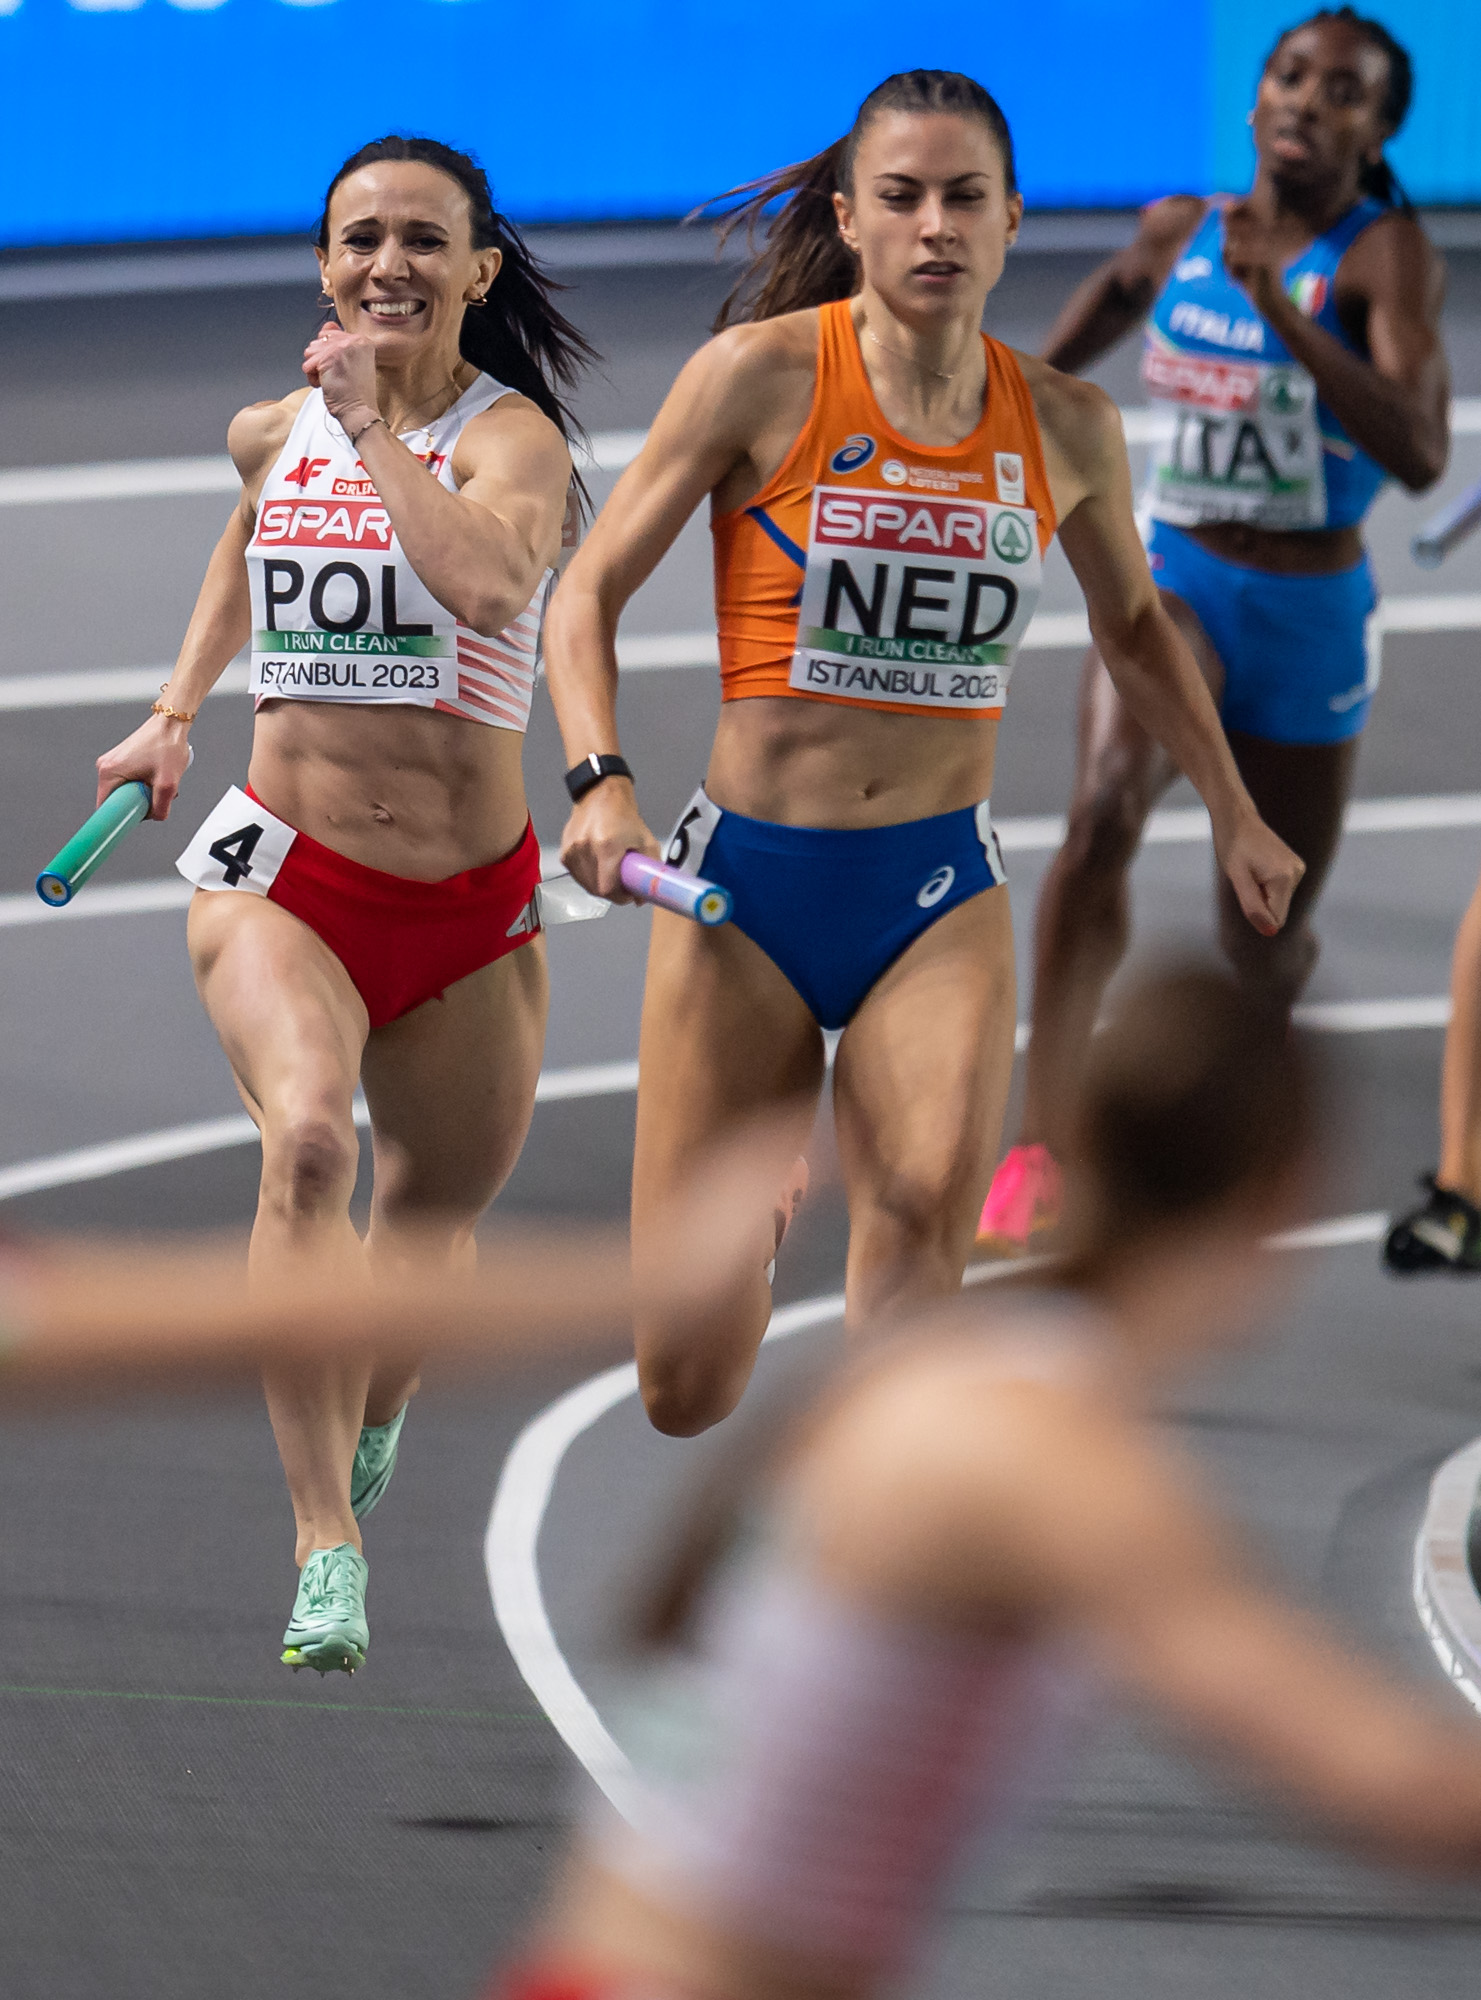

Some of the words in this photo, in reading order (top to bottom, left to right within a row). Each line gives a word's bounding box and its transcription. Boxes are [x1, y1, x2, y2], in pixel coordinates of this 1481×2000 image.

[1168, 300, 1265, 352] ITALIA
[1172, 414, 1281, 483] ITA
[284, 456, 332, 488] 4F
[260, 505, 392, 543] SPAR
[820, 499, 984, 552] SPAR
[263, 558, 434, 638] POL
[822, 557, 1019, 648] NED
[283, 633, 290, 650] I
[292, 633, 324, 651] RUN
[858, 637, 905, 659] RUN
[260, 660, 367, 688] ISTANBUL
[371, 663, 440, 690] 2023
[806, 658, 944, 698] ISTANBUL
[207, 822, 265, 888] 4
